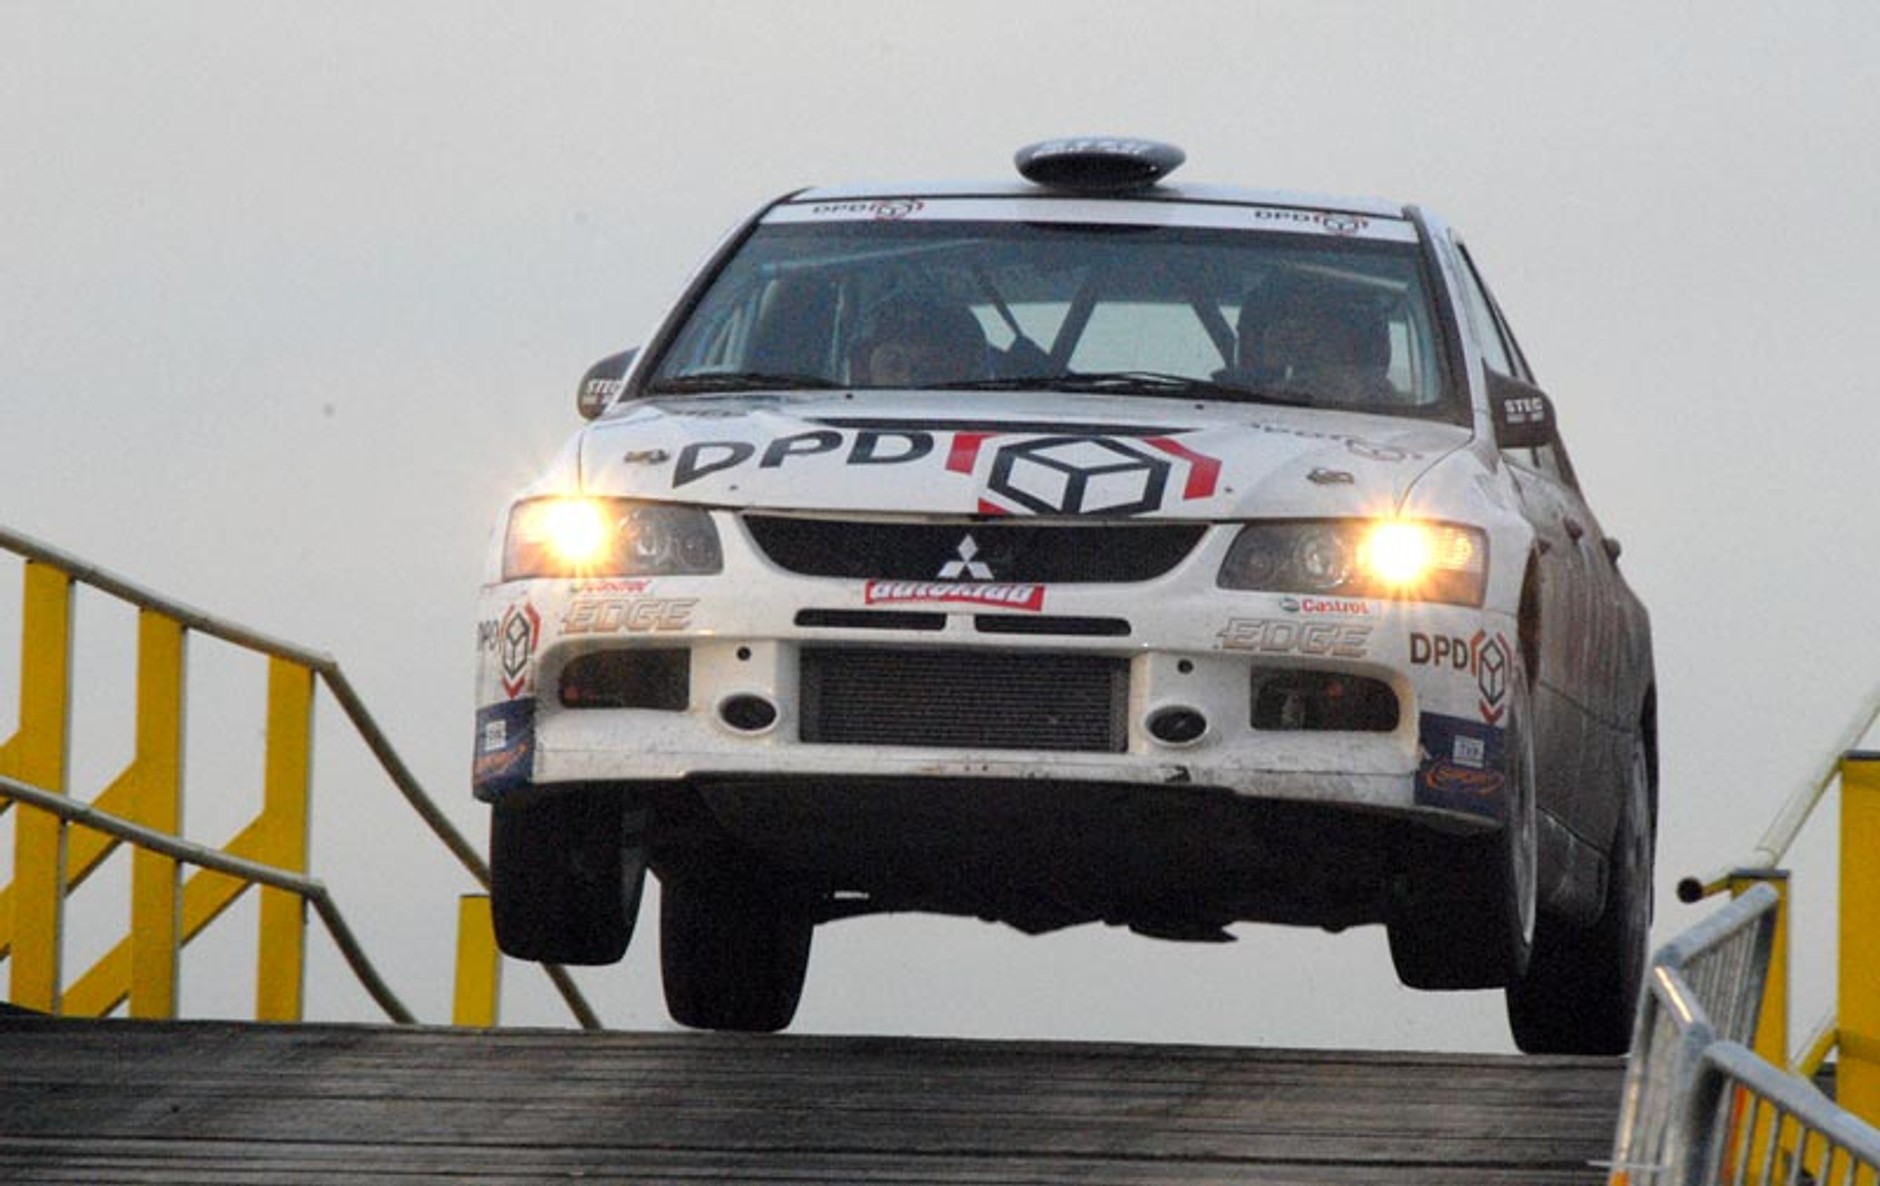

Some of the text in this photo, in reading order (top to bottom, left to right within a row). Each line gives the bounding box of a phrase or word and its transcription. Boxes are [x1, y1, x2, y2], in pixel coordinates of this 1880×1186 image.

[672, 426, 935, 489] DPD
[562, 599, 696, 632] EDGE
[1301, 599, 1370, 615] Castrol
[1216, 618, 1374, 658] EDGE
[1410, 632, 1467, 669] DPD
